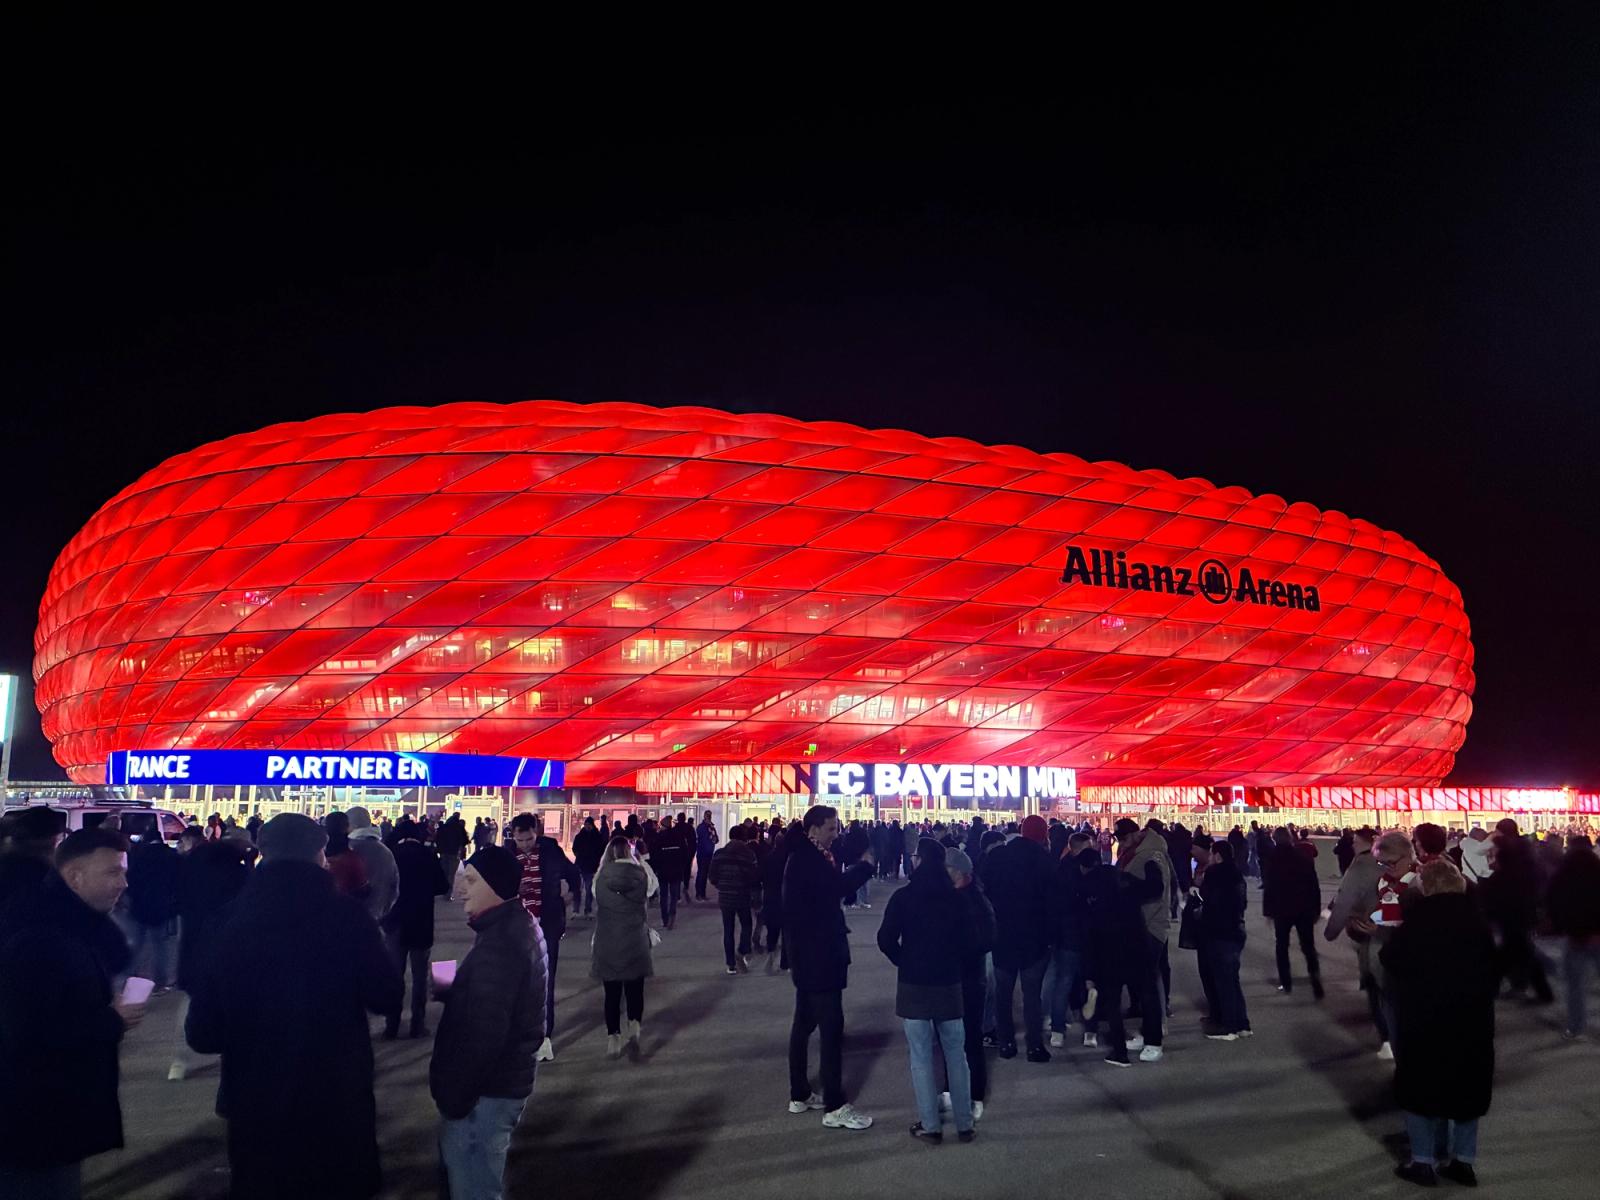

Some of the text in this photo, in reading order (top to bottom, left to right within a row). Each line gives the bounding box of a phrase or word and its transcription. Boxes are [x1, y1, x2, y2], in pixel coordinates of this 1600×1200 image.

[1062, 545, 1320, 612] Allianz Arena
[266, 756, 392, 780] PARTNER
[397, 757, 427, 780] EN
[818, 763, 866, 796] FC
[874, 763, 1019, 797] BAYERN
